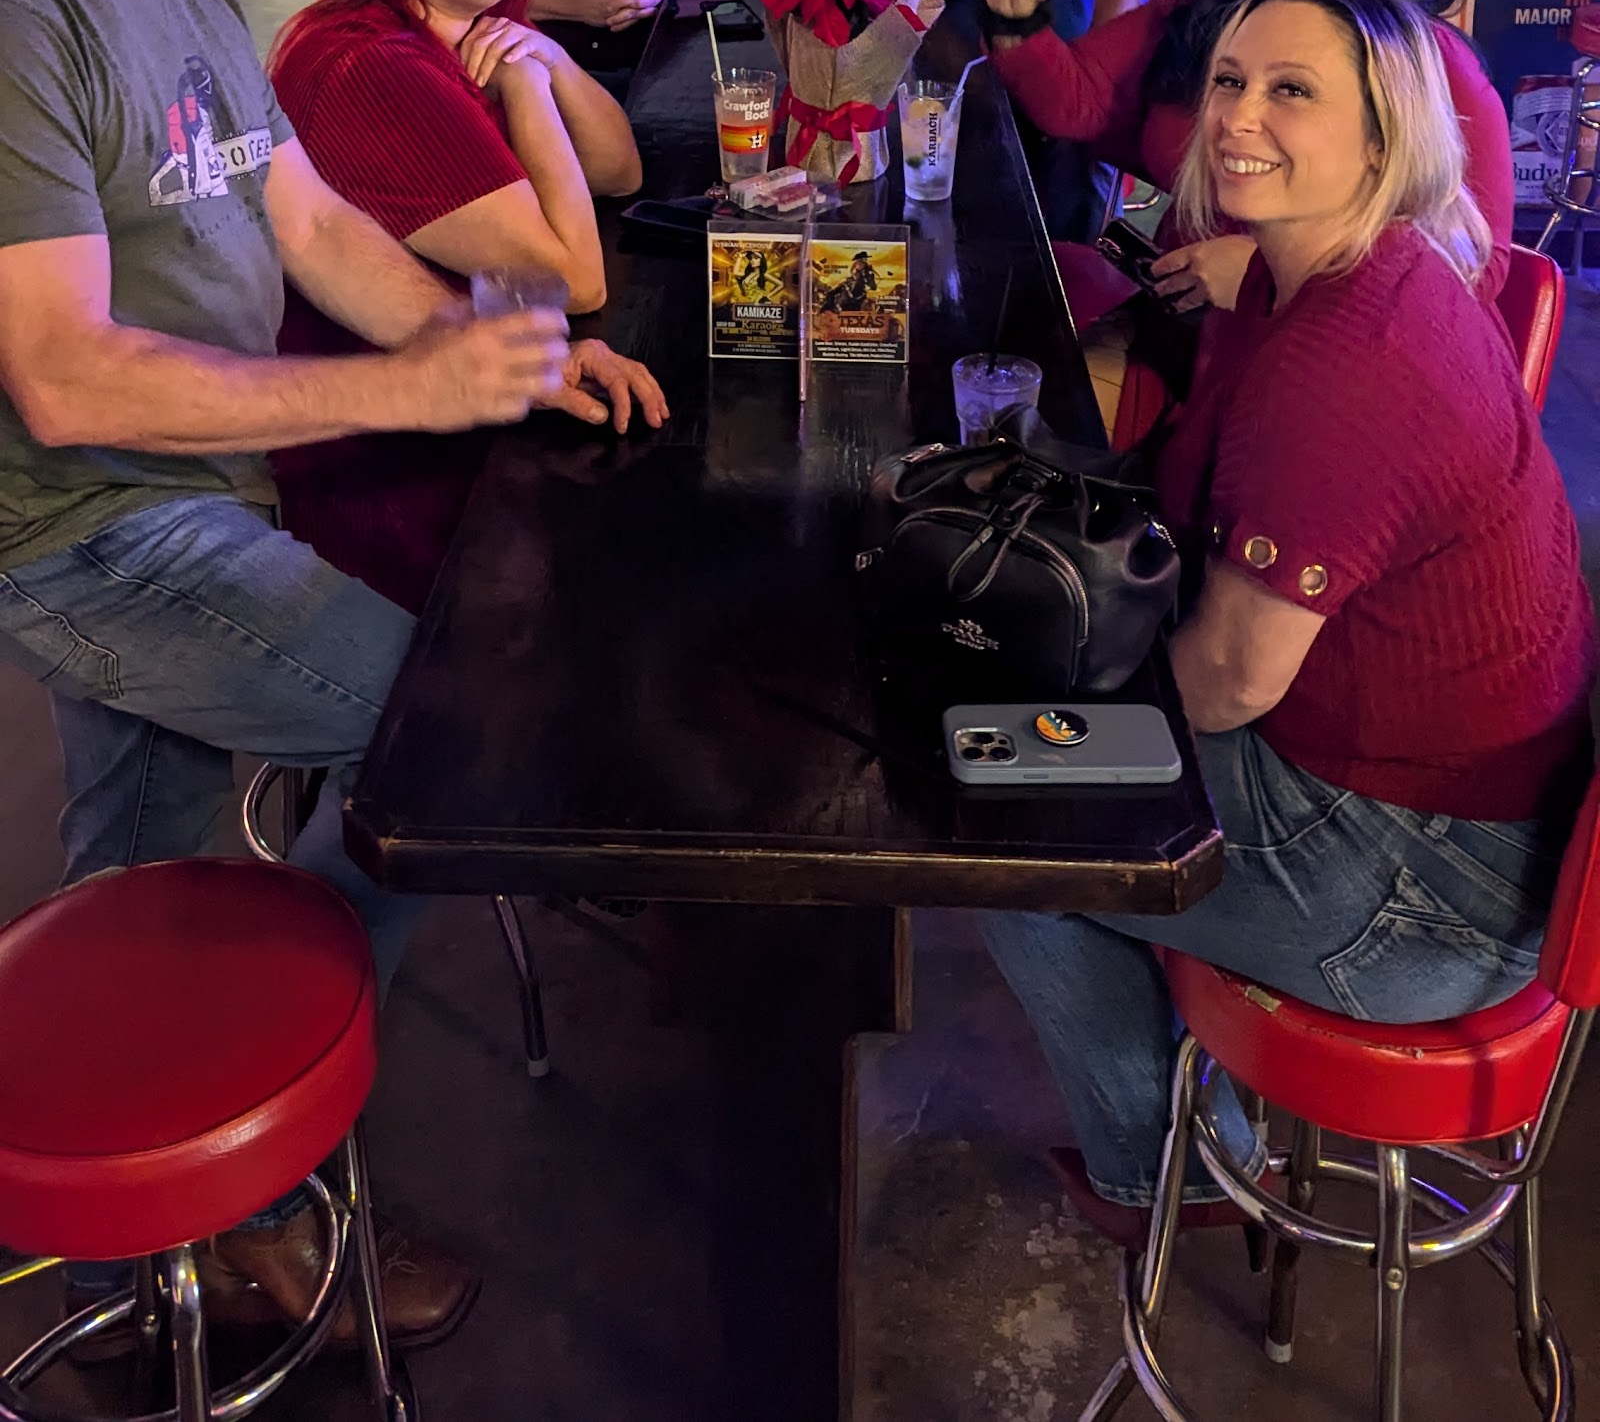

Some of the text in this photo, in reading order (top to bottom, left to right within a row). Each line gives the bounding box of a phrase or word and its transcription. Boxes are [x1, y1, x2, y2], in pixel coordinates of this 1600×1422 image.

[1515, 8, 1572, 25] MAJOR
[723, 97, 770, 112] Crawford
[744, 108, 769, 121] Bock
[751, 134, 764, 149] H
[928, 112, 938, 167] KARBACH
[736, 306, 782, 319] KAMIKAZE
[741, 319, 784, 330] Karaoke
[838, 315, 884, 328] TEXAS
